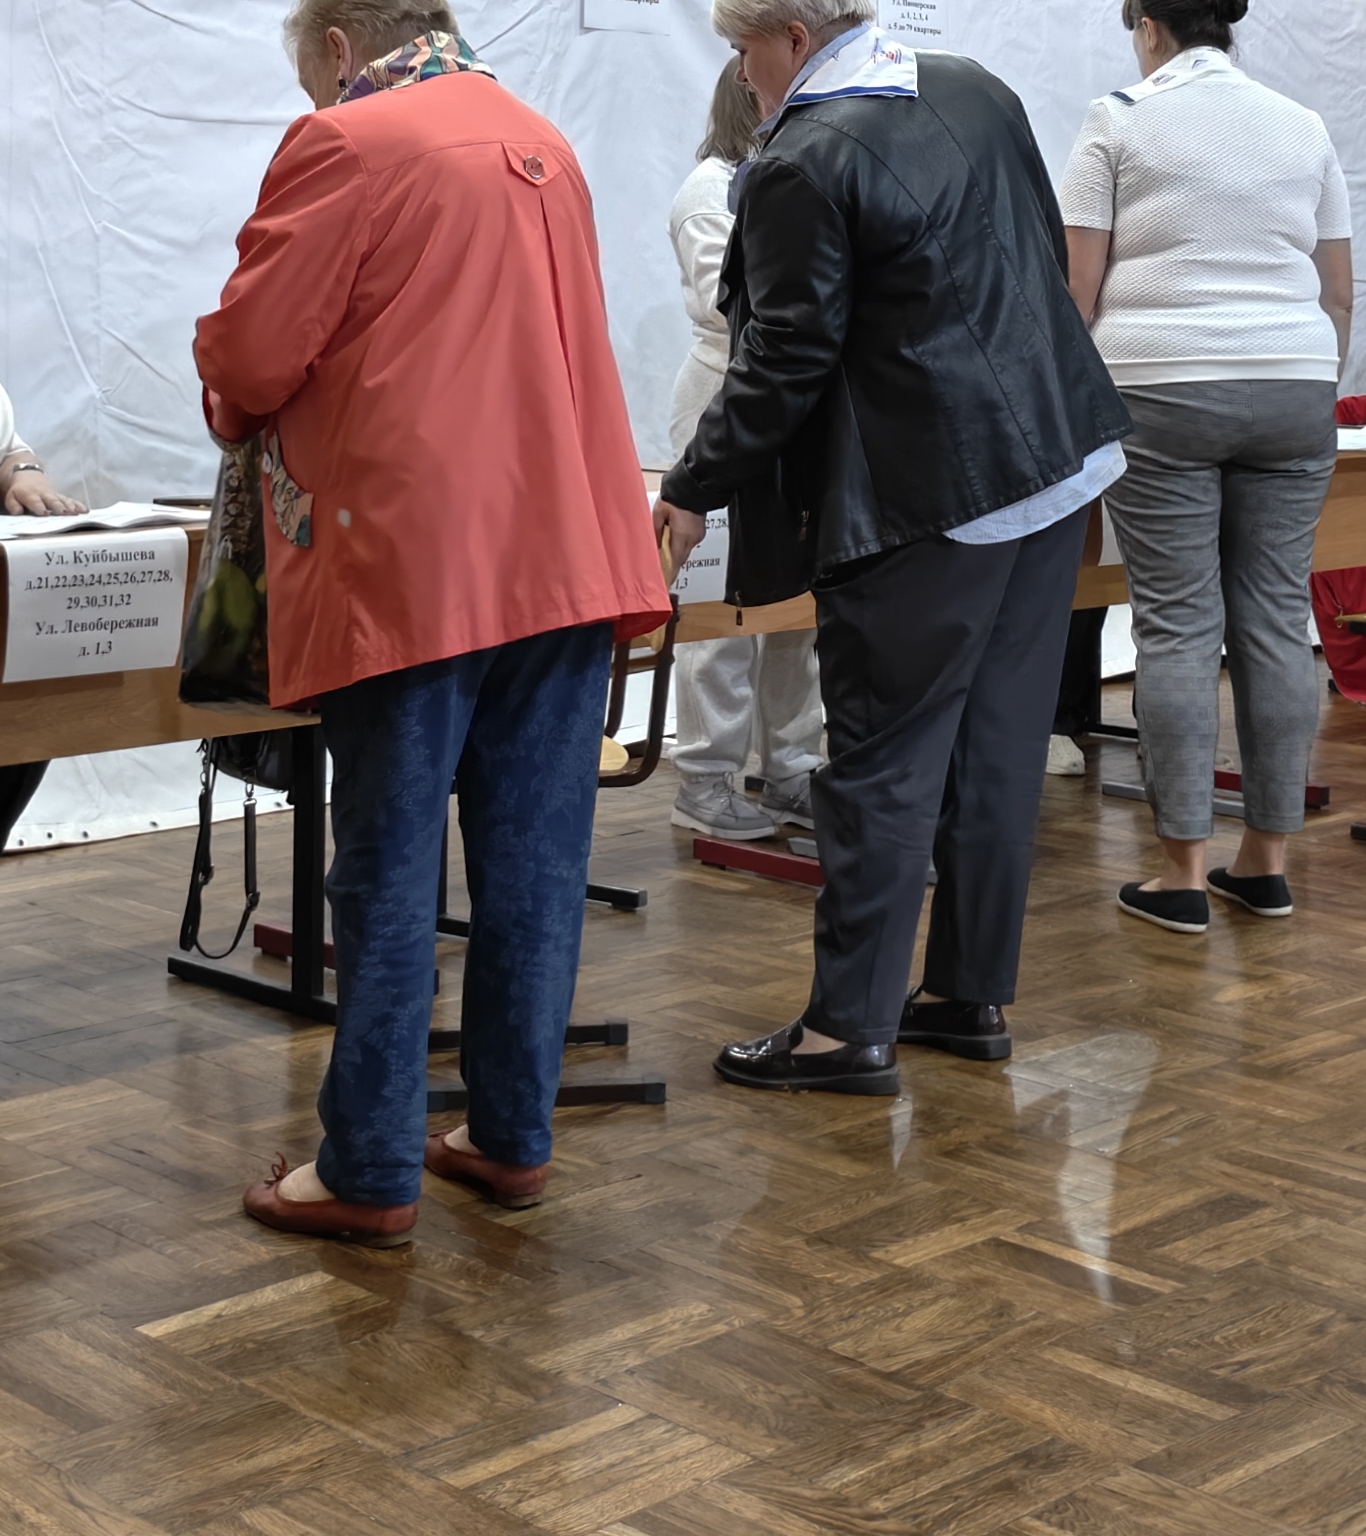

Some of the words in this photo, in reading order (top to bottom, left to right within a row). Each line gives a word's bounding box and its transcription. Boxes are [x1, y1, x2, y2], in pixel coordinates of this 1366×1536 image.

[44, 551, 69, 566] Ул.
[73, 549, 155, 567] Куйбышева
[24, 569, 174, 591] д.21,22,23,24,25,26,27,28,
[66, 593, 132, 609] 29,30,31,32
[35, 621, 58, 636] Ул.
[61, 616, 159, 634] Левобережная
[77, 645, 90, 657] д.
[94, 641, 113, 657] 1,3
